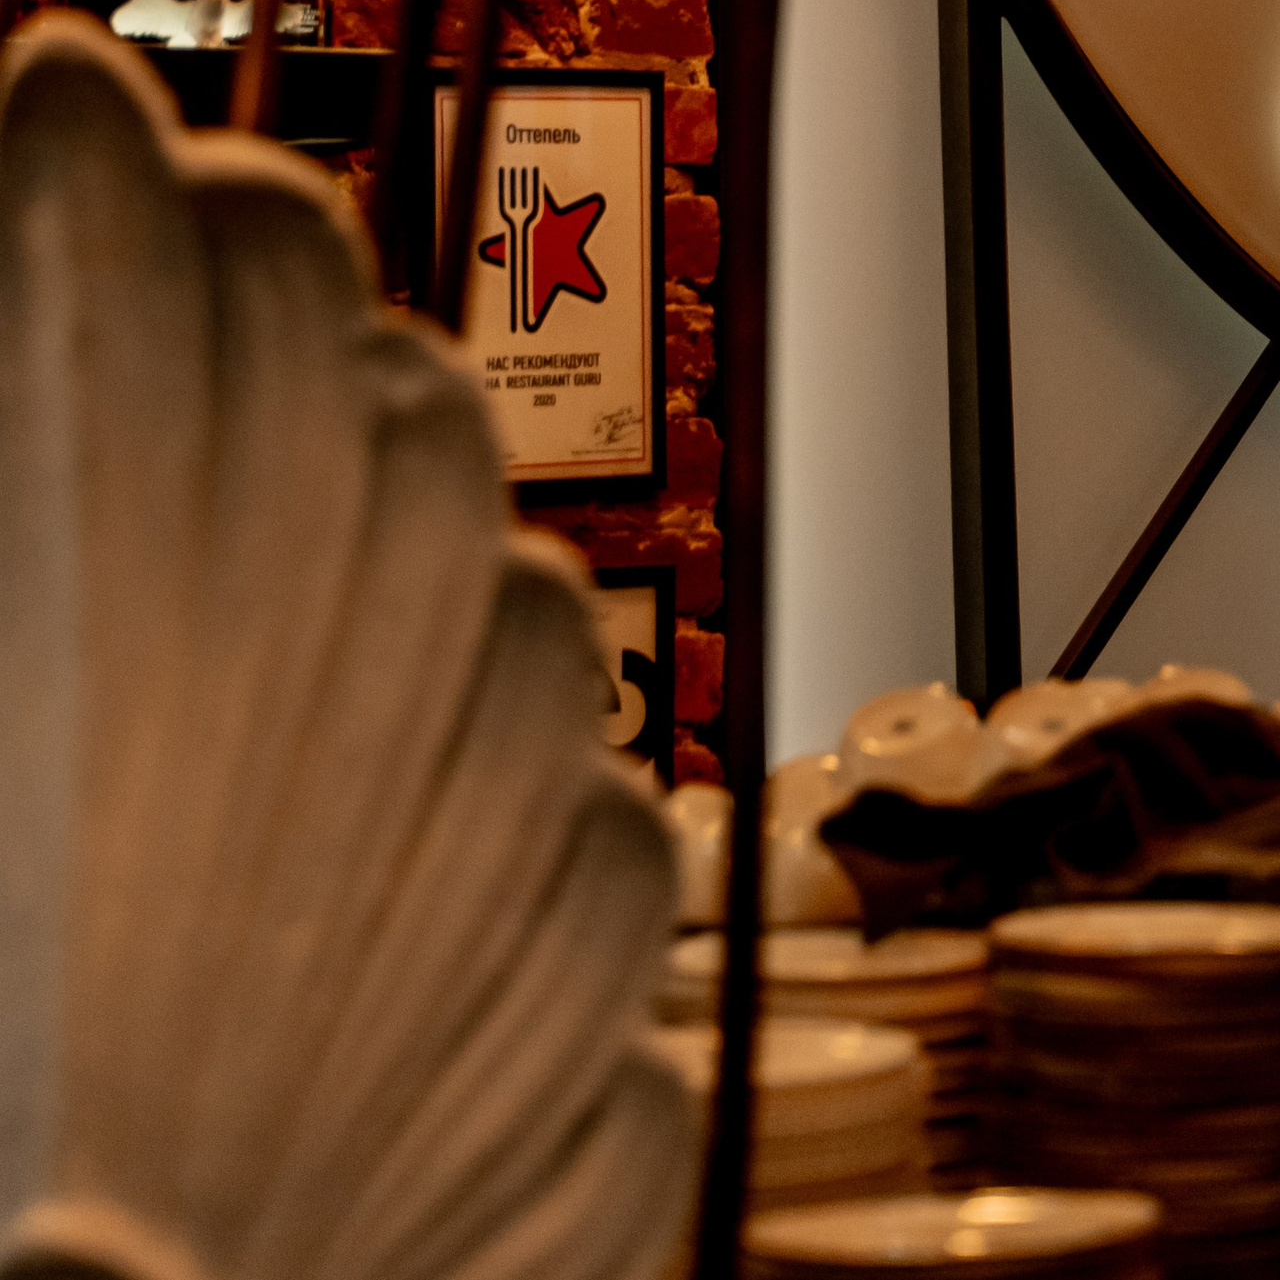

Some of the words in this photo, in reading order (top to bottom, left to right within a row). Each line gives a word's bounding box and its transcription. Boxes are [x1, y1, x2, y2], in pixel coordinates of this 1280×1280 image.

[506, 123, 581, 145] Оттепель
[487, 355, 509, 371] НАС
[513, 353, 600, 370] РЕКОМЕНДУЮТ
[506, 374, 571, 389] RESTAURANT
[573, 372, 601, 387] GURU
[533, 394, 556, 406] 2020
